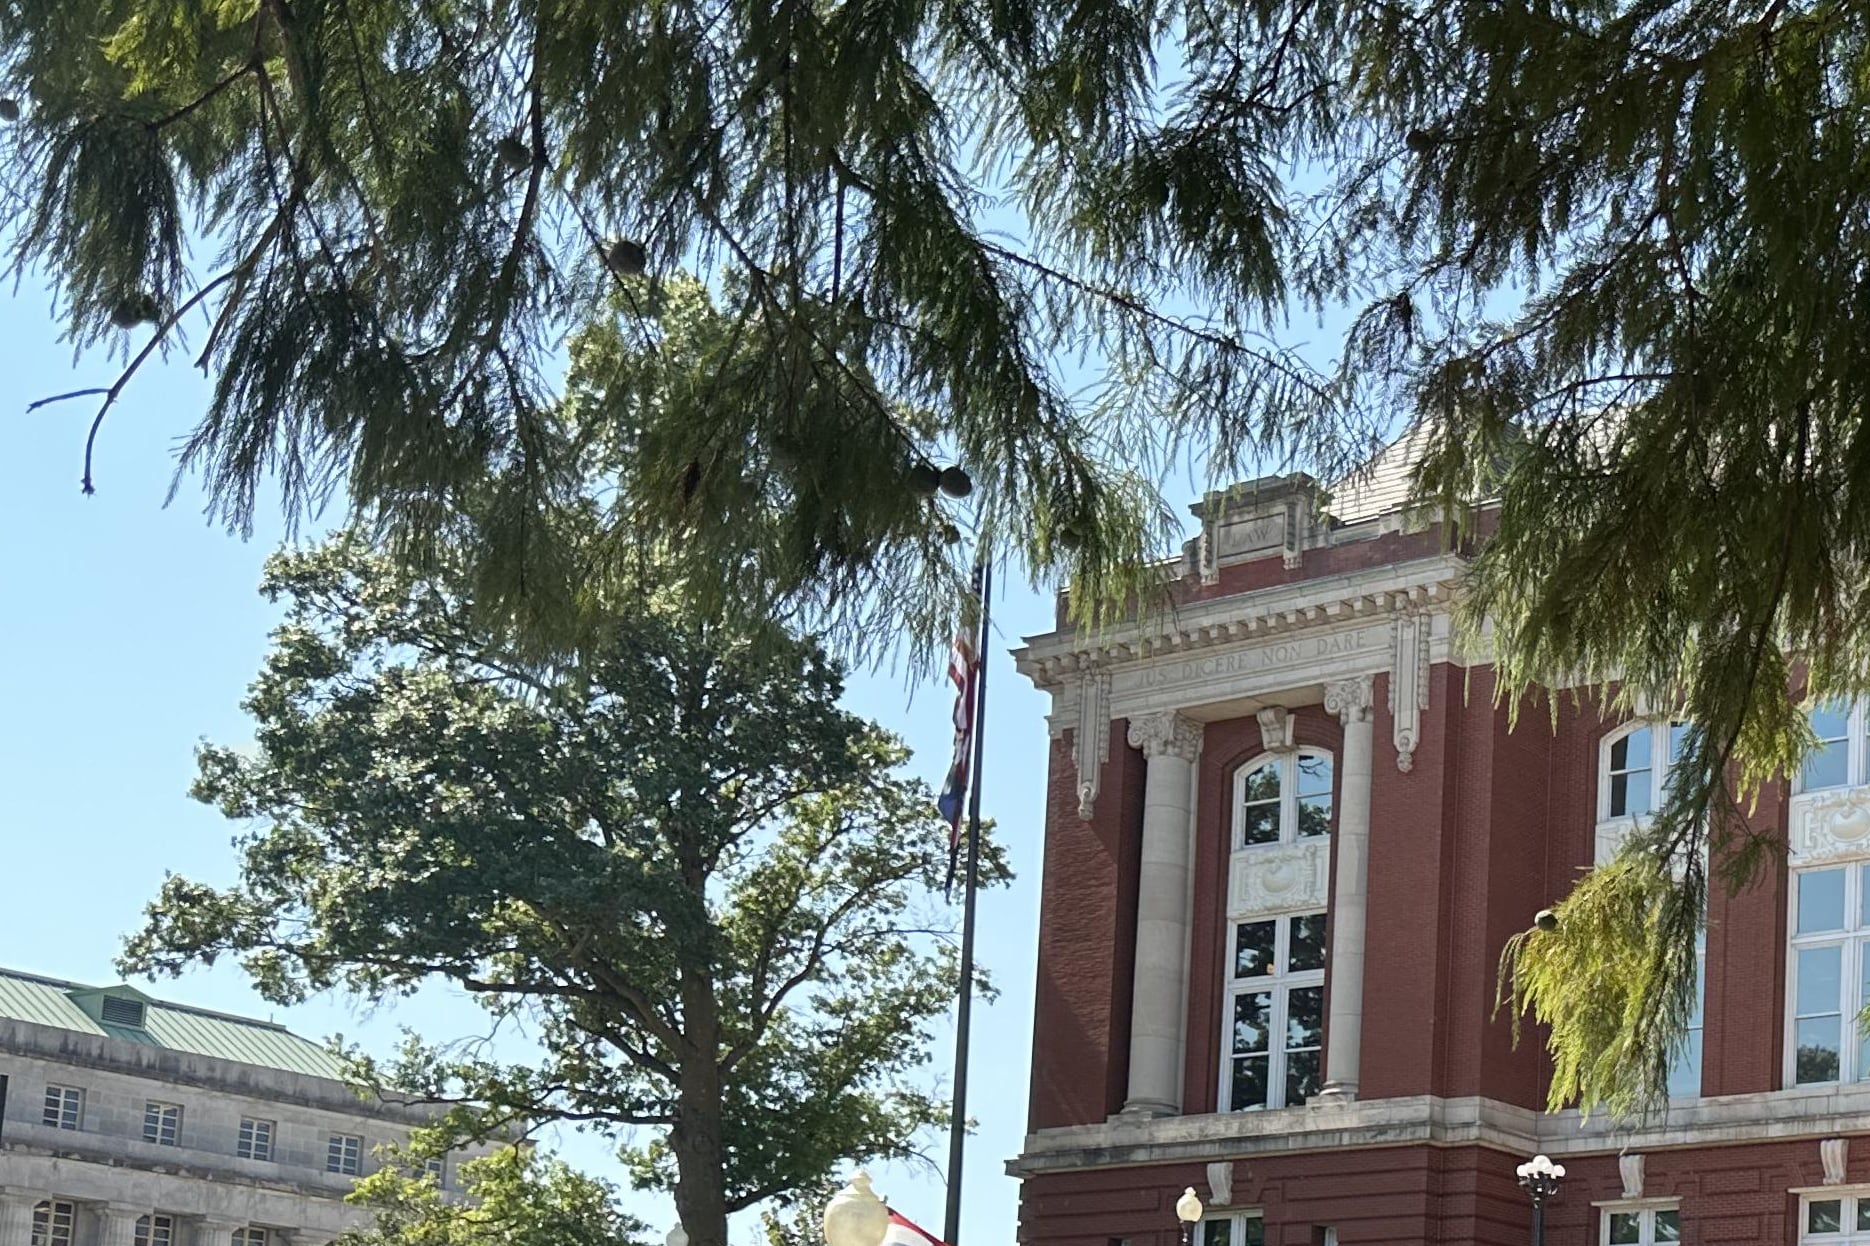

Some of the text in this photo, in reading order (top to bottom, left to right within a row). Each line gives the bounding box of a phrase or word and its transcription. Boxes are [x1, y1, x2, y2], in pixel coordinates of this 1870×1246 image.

[1231, 524, 1274, 548] LAW
[1135, 631, 1366, 688] JUS DICERE NON DARE
